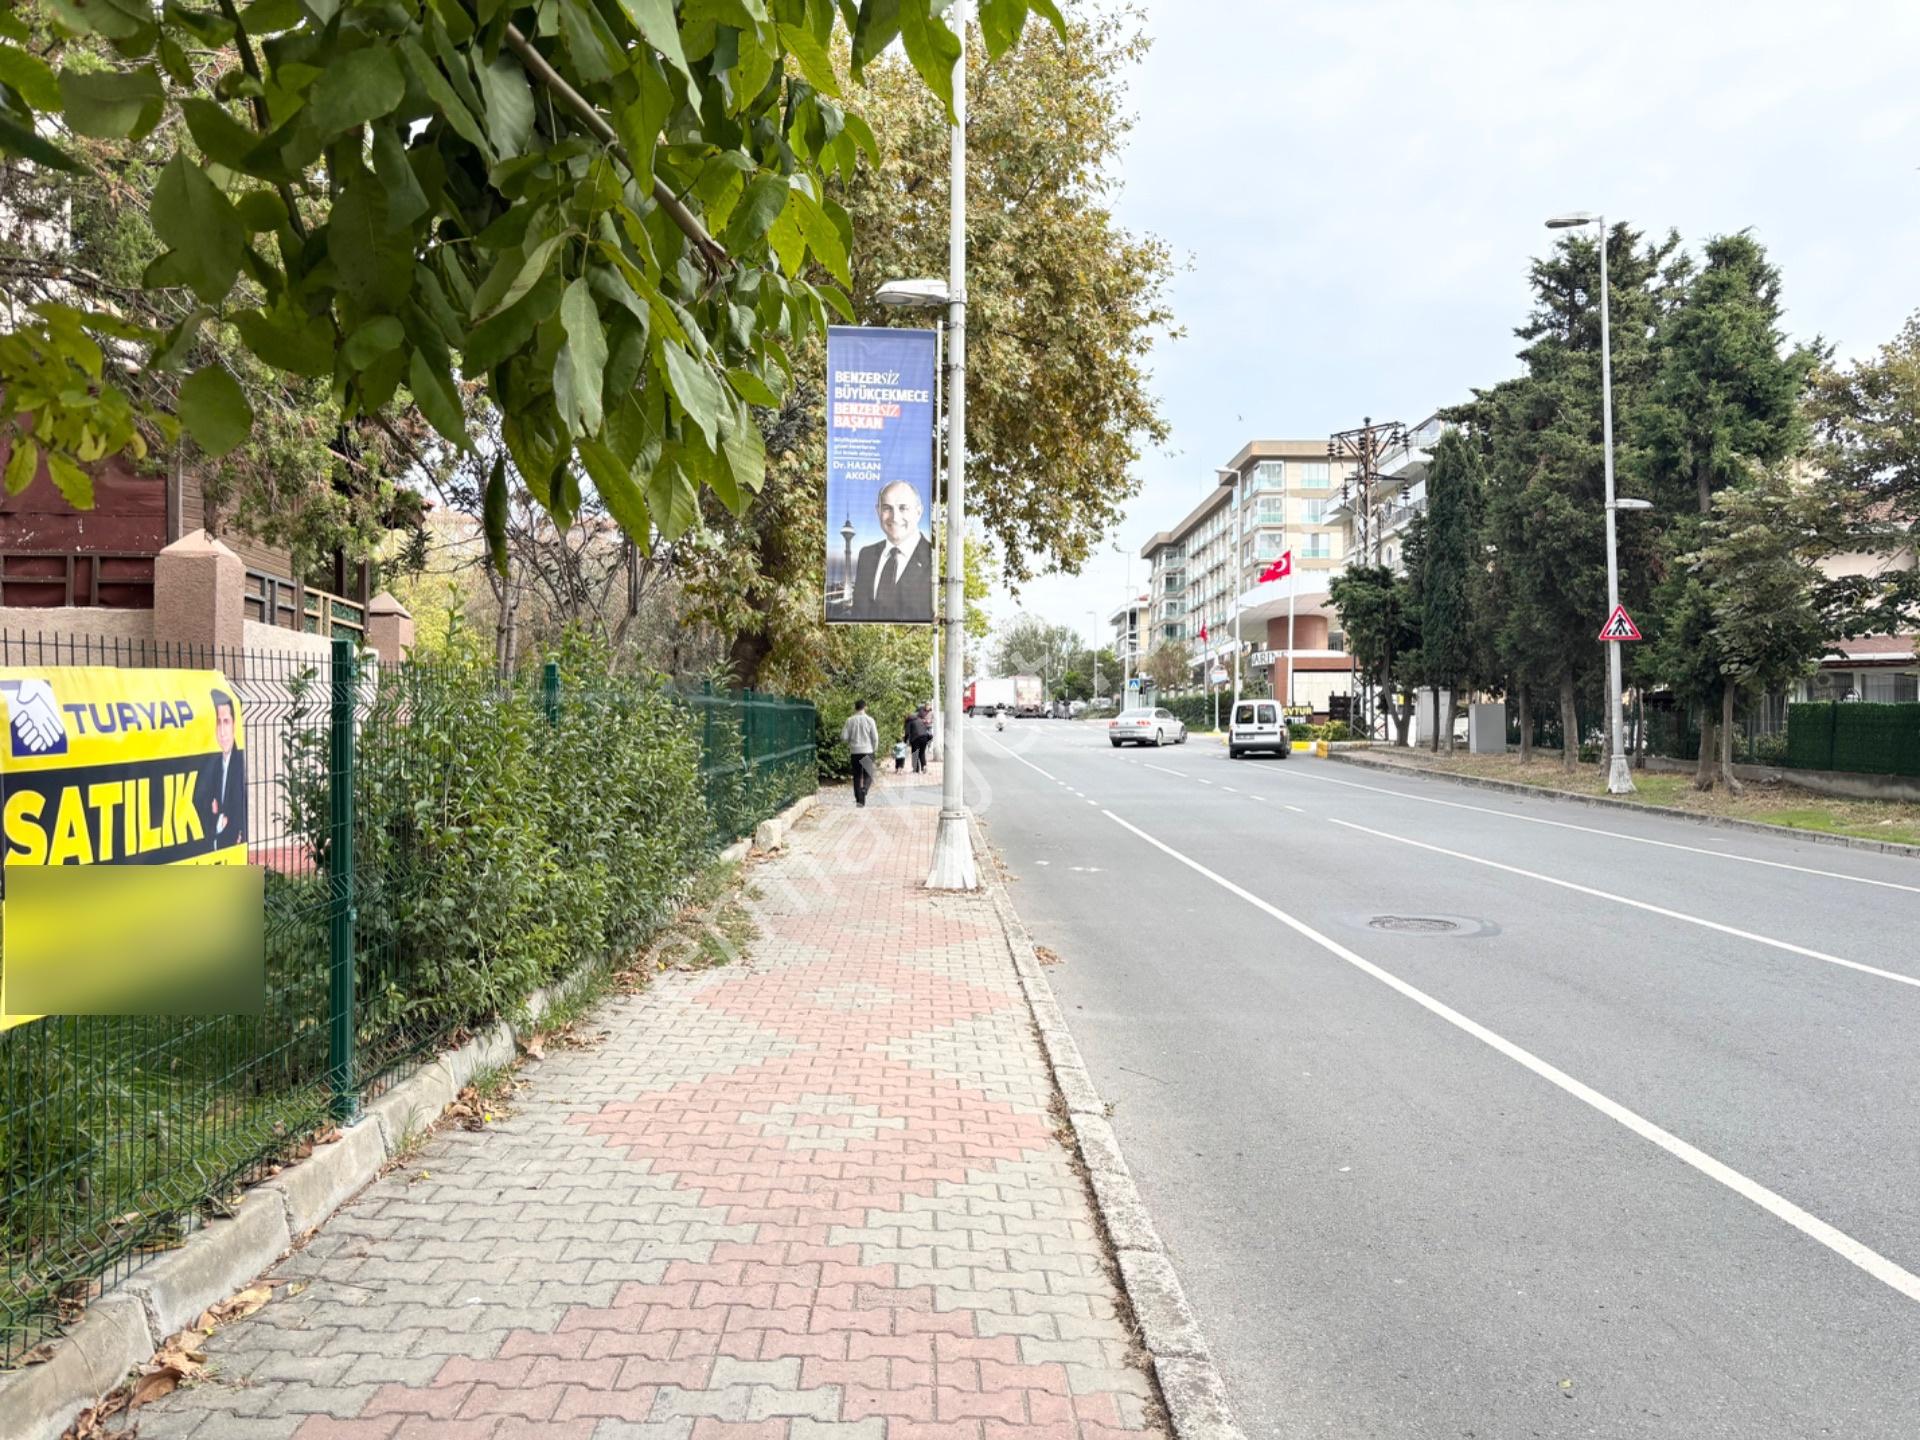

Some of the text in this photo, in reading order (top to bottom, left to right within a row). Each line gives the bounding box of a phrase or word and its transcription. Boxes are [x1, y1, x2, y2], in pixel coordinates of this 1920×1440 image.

[835, 369, 900, 384] BENZERSİZ
[834, 384, 929, 403] BÜYÜKÇEKMECE
[834, 401, 900, 416] BENZERSİZ
[834, 416, 883, 432] BAŞKAN
[833, 461, 881, 470] Dr. HASAN
[845, 471, 880, 481] AKGÜN
[63, 700, 194, 734] TURYAP
[3, 771, 204, 865] SATILIK
